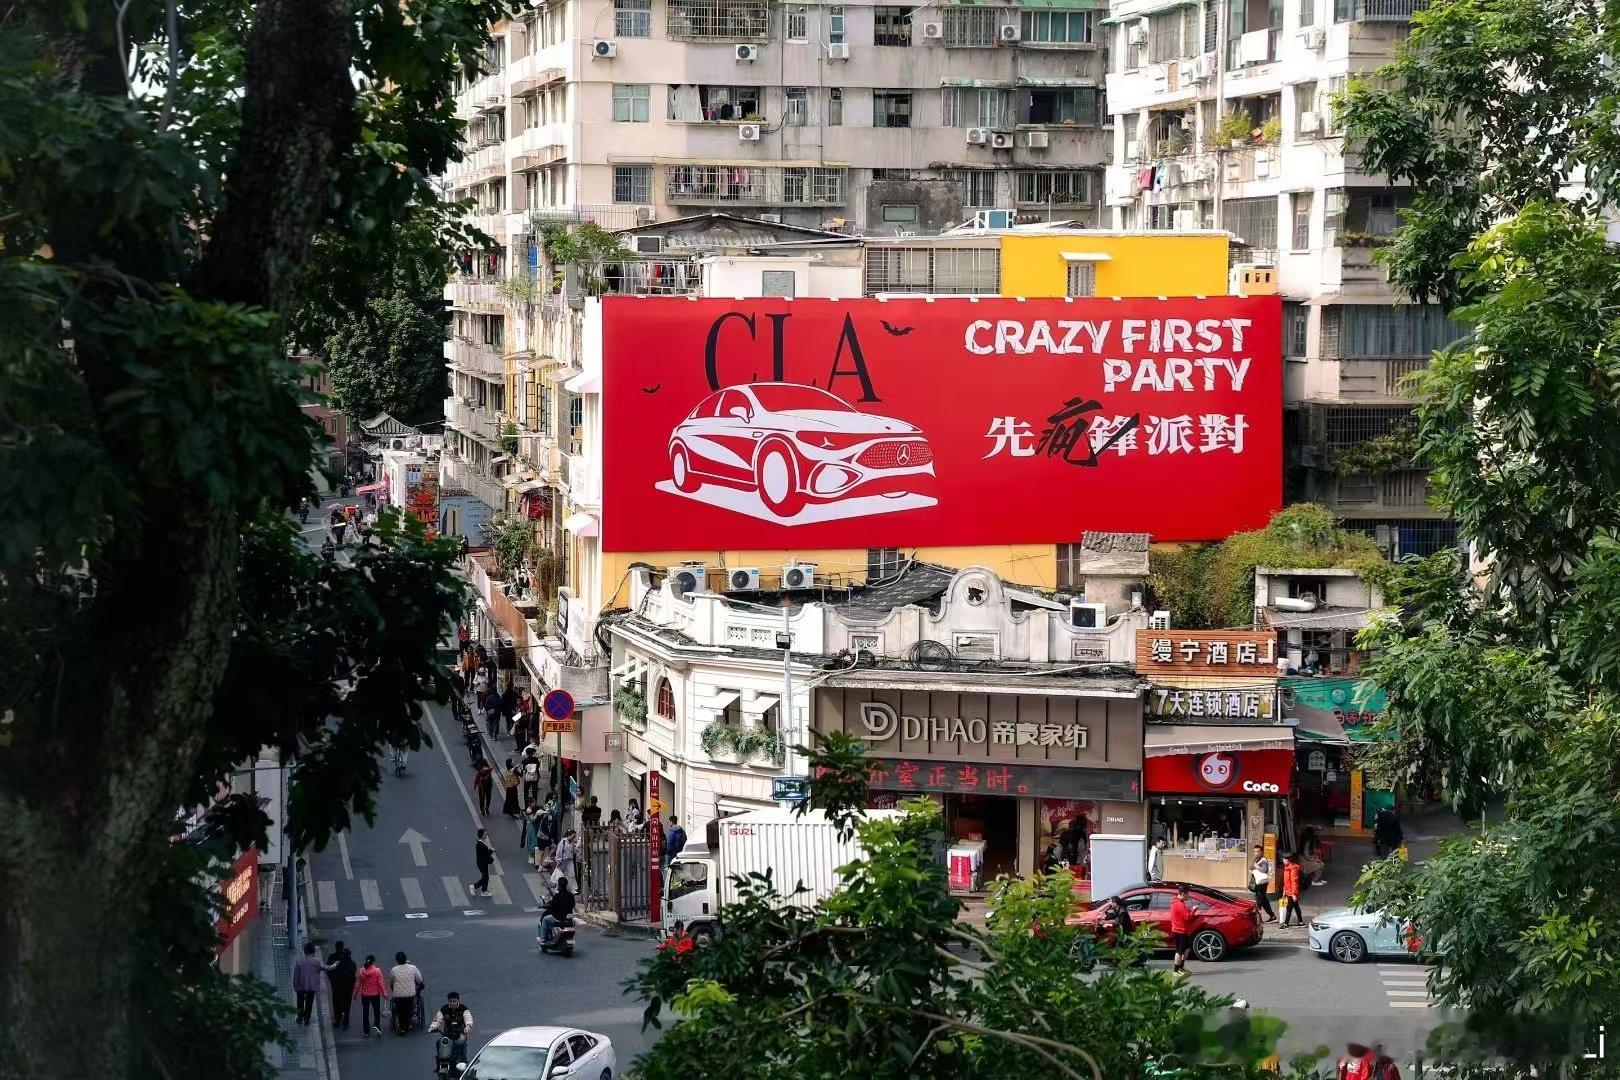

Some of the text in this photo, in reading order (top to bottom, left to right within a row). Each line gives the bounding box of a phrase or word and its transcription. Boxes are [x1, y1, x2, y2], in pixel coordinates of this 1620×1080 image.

[965, 318, 1252, 355] CRAZY FIRST
[705, 311, 882, 403] CLA
[1103, 357, 1251, 393] PARTY
[1151, 638, 1257, 665] 缦宁酒店
[1156, 689, 1260, 718] 7天连锁酒店
[900, 715, 987, 744] DIHAO
[991, 721, 1088, 748] 帝豪家纺
[1242, 780, 1280, 794] CoCo
